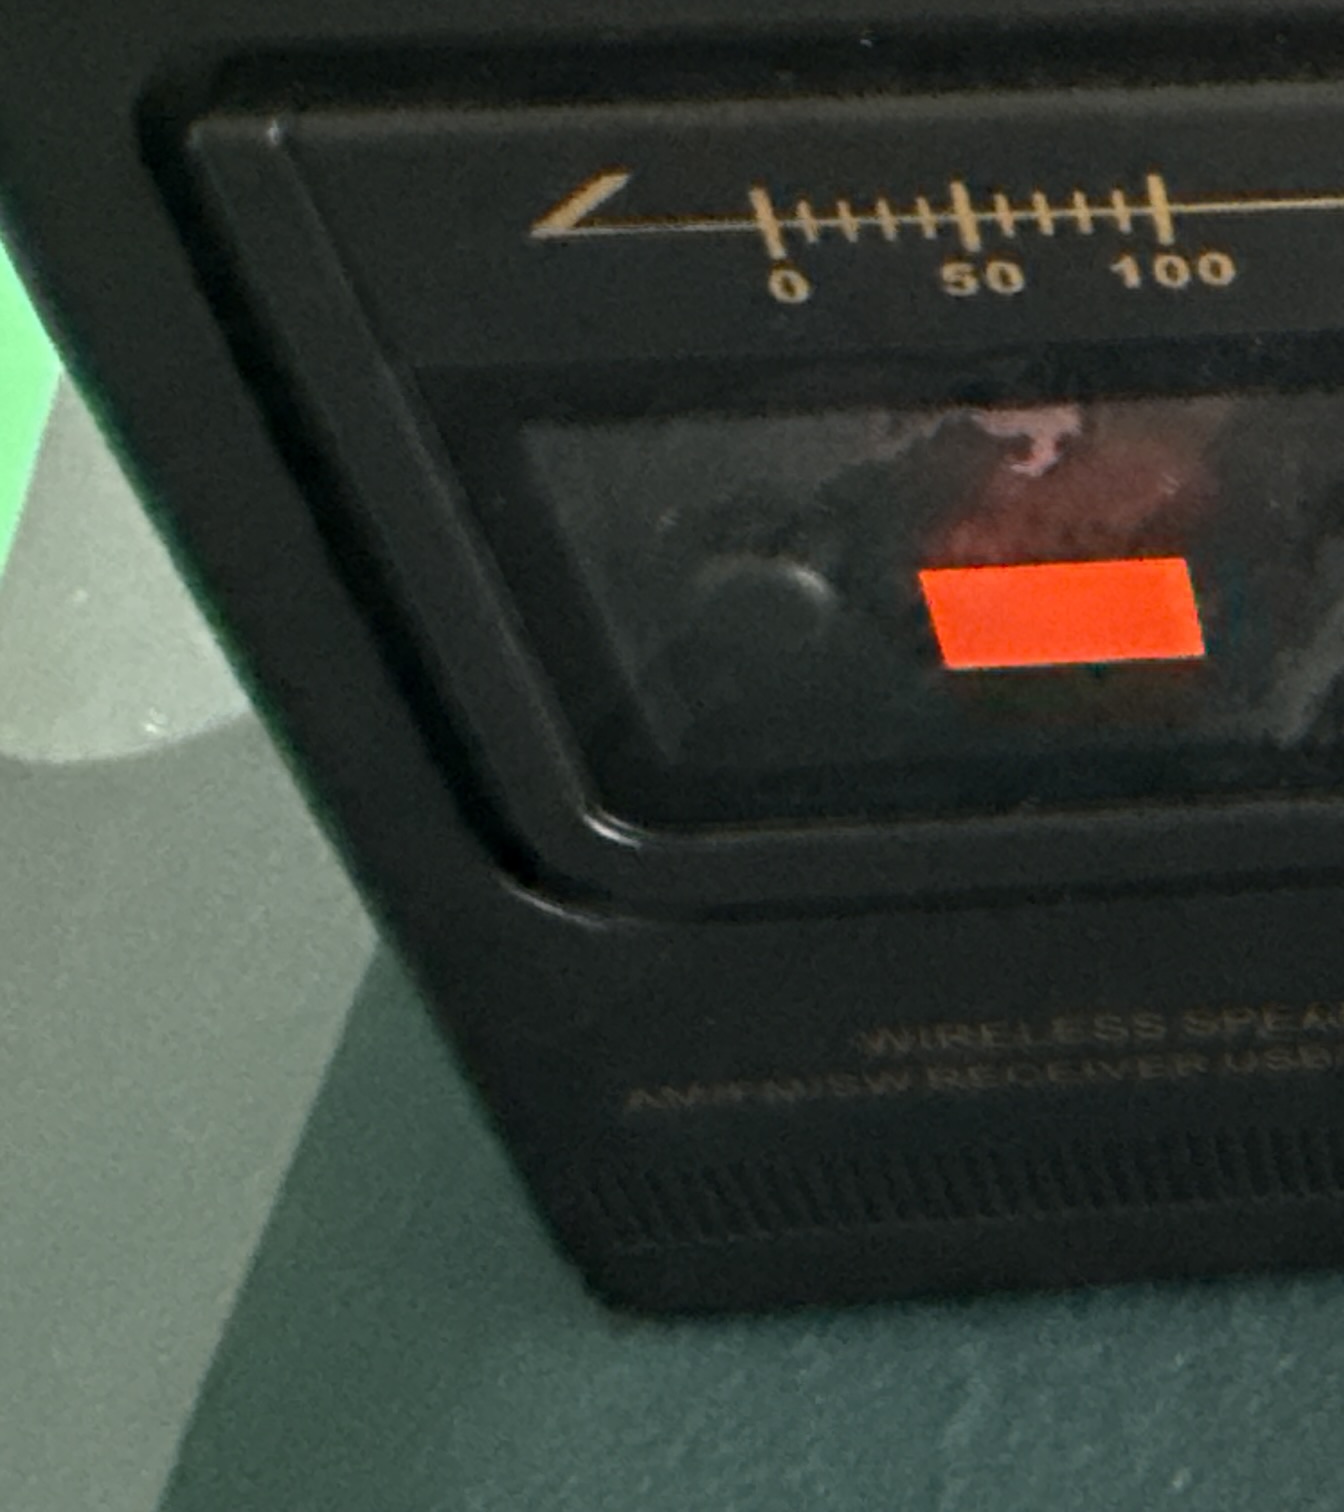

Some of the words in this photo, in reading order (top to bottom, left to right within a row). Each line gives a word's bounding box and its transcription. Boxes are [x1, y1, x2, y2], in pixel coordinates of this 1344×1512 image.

[768, 269, 810, 303] 0
[941, 261, 1025, 296] 50
[1111, 252, 1236, 289] 100
[860, 1009, 1168, 1056] WIRELESS
[922, 1050, 1208, 1092] RECEIVER
